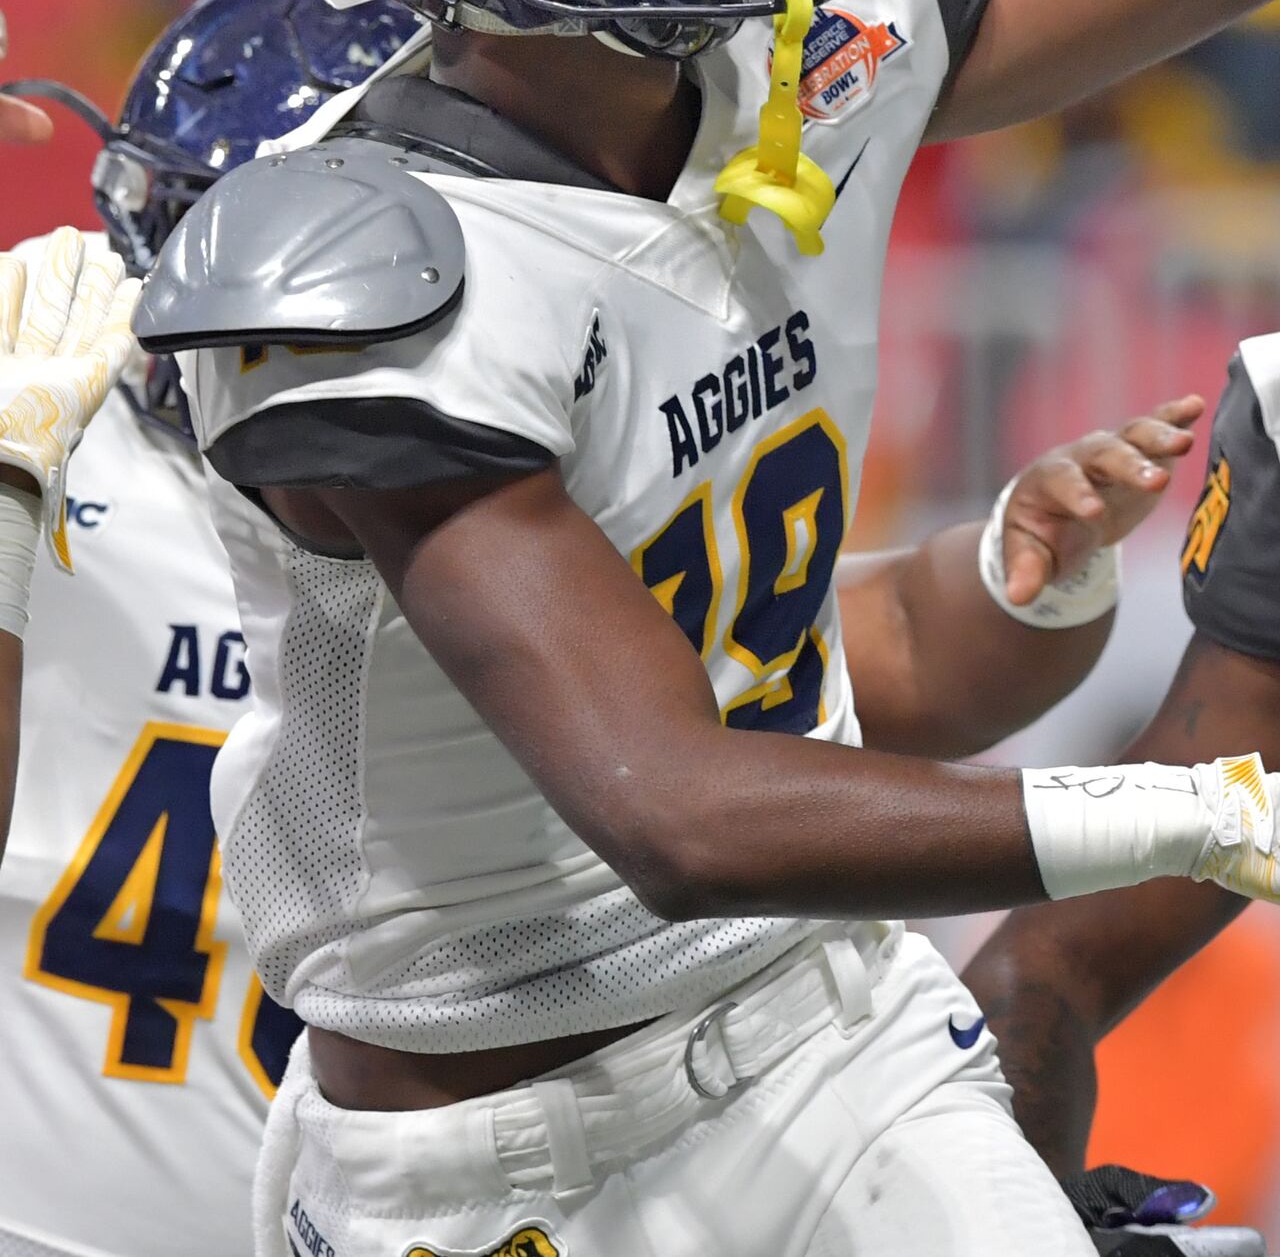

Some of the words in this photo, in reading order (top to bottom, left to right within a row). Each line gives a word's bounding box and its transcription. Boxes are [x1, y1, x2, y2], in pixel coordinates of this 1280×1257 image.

[802, 30, 850, 70] ESERVE
[821, 71, 858, 105] BOWL
[658, 310, 817, 478] AGGIES
